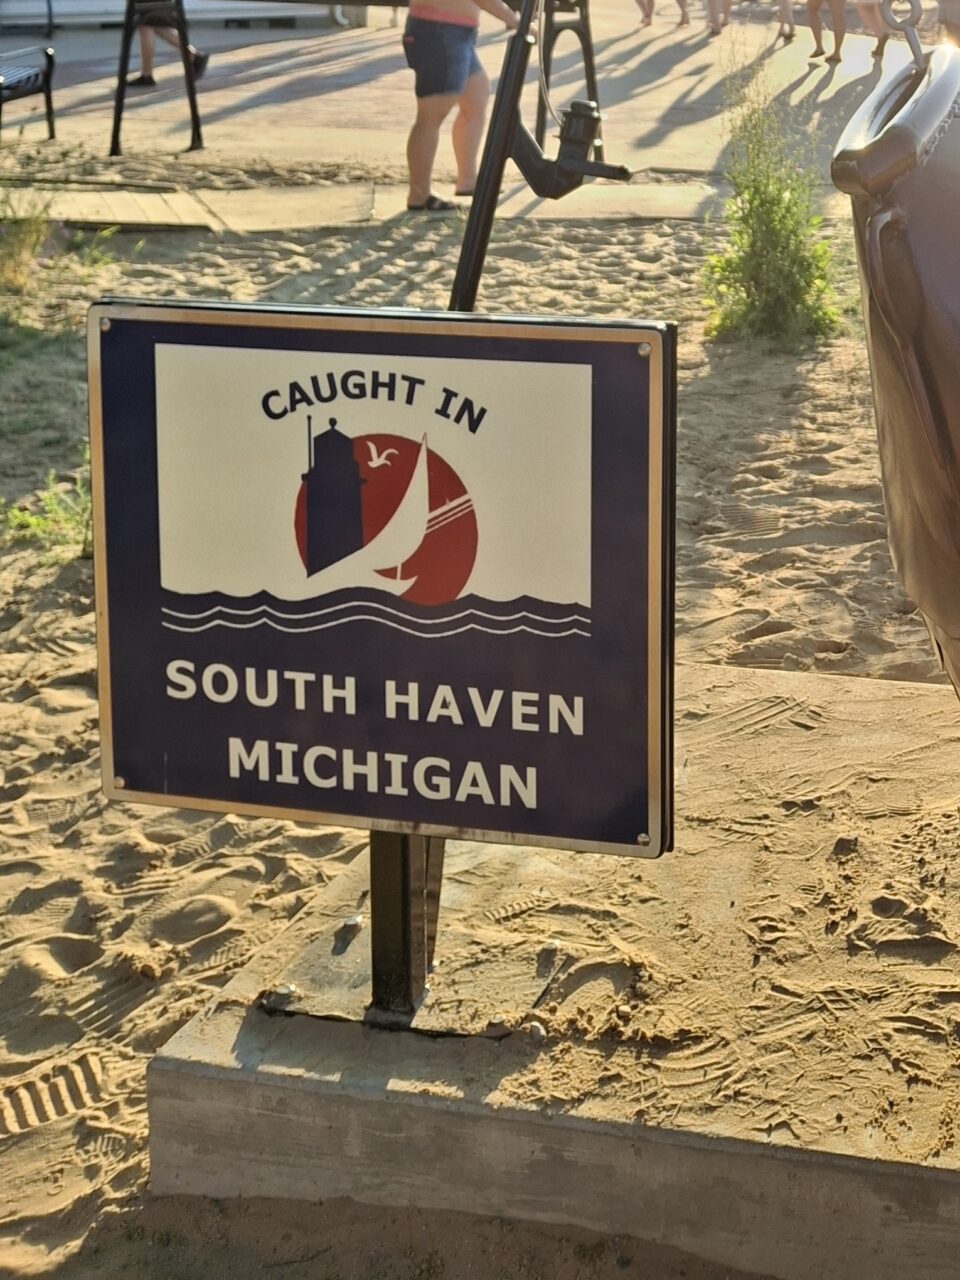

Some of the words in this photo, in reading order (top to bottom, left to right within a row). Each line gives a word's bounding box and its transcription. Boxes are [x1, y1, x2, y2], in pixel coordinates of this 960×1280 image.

[261, 369, 426, 421] CAUGHT
[434, 387, 488, 435] IN
[165, 659, 357, 715] SOUTH
[384, 679, 585, 737] HAVEN
[228, 737, 539, 810] MICHIGAN
